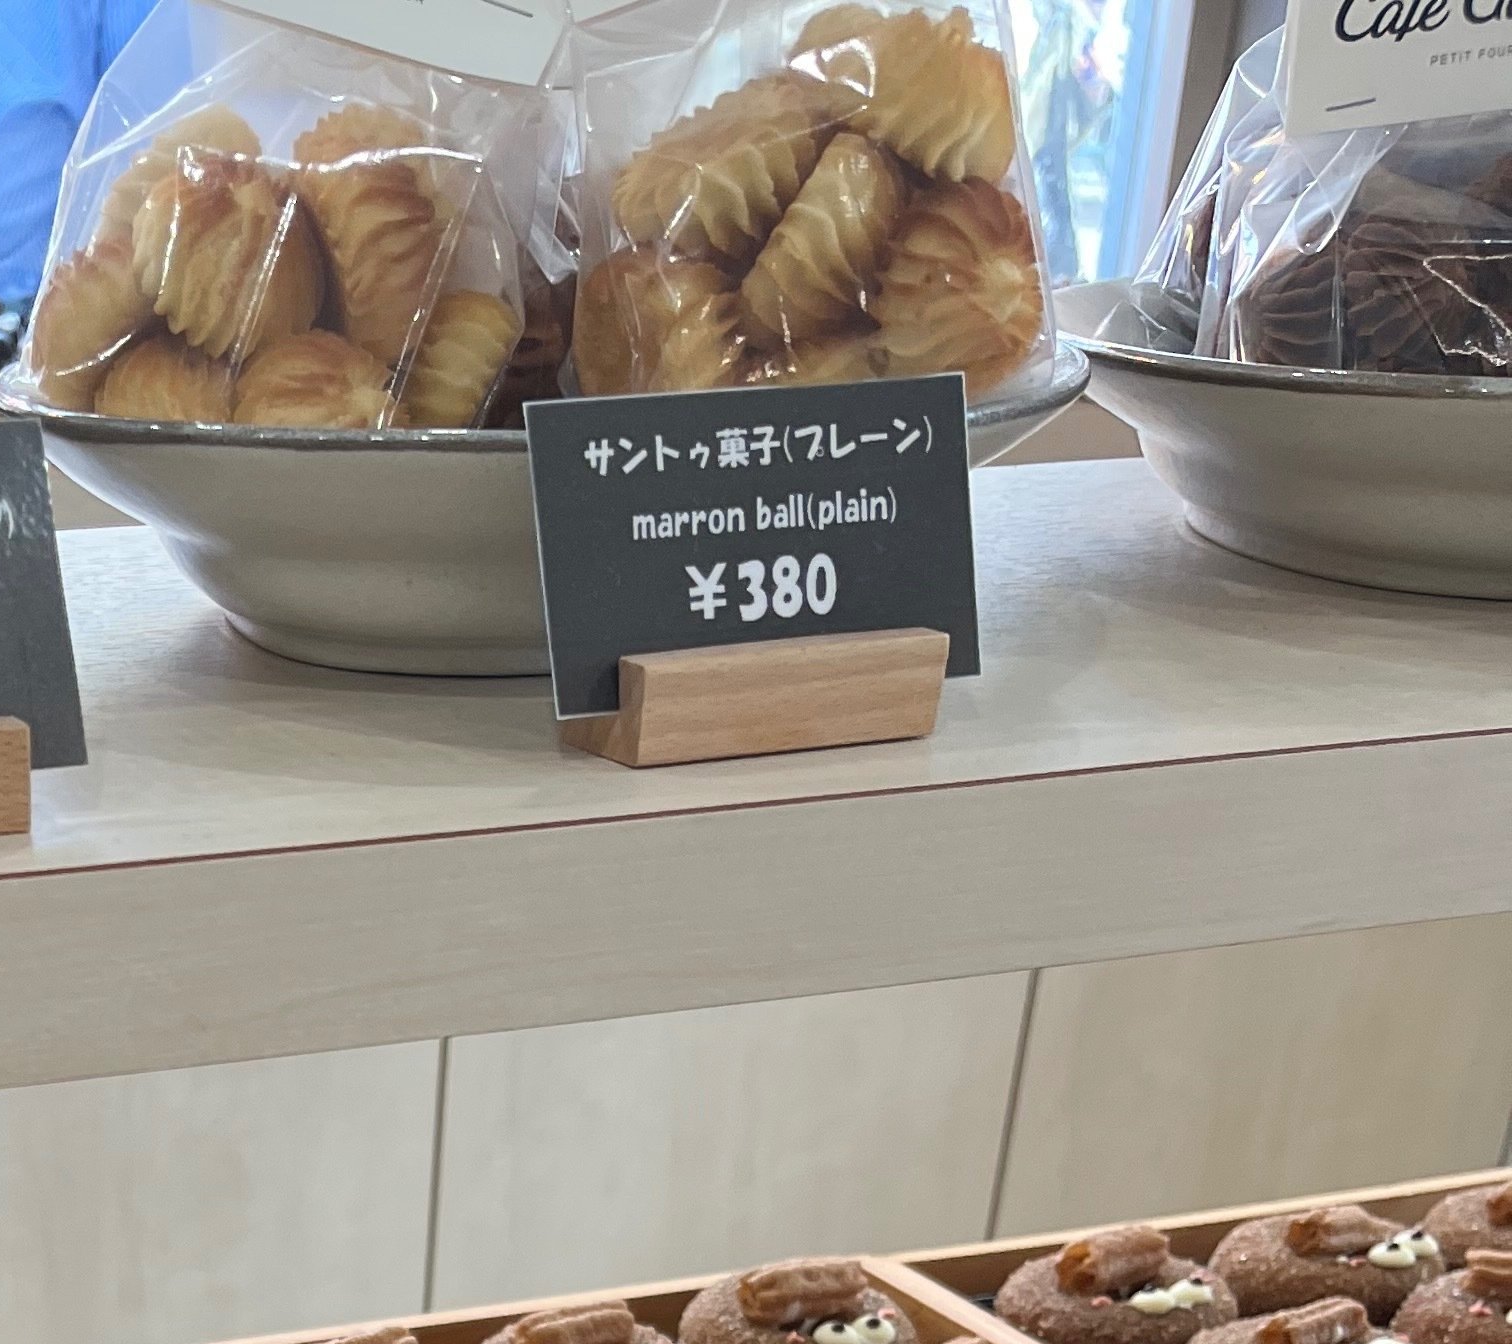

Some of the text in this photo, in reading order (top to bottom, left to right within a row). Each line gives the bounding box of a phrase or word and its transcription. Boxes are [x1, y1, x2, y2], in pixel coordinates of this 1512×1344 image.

[1429, 50, 1472, 66] PETIT
[632, 485, 897, 541] marron ball(plain)
[685, 552, 838, 622] ¥380
